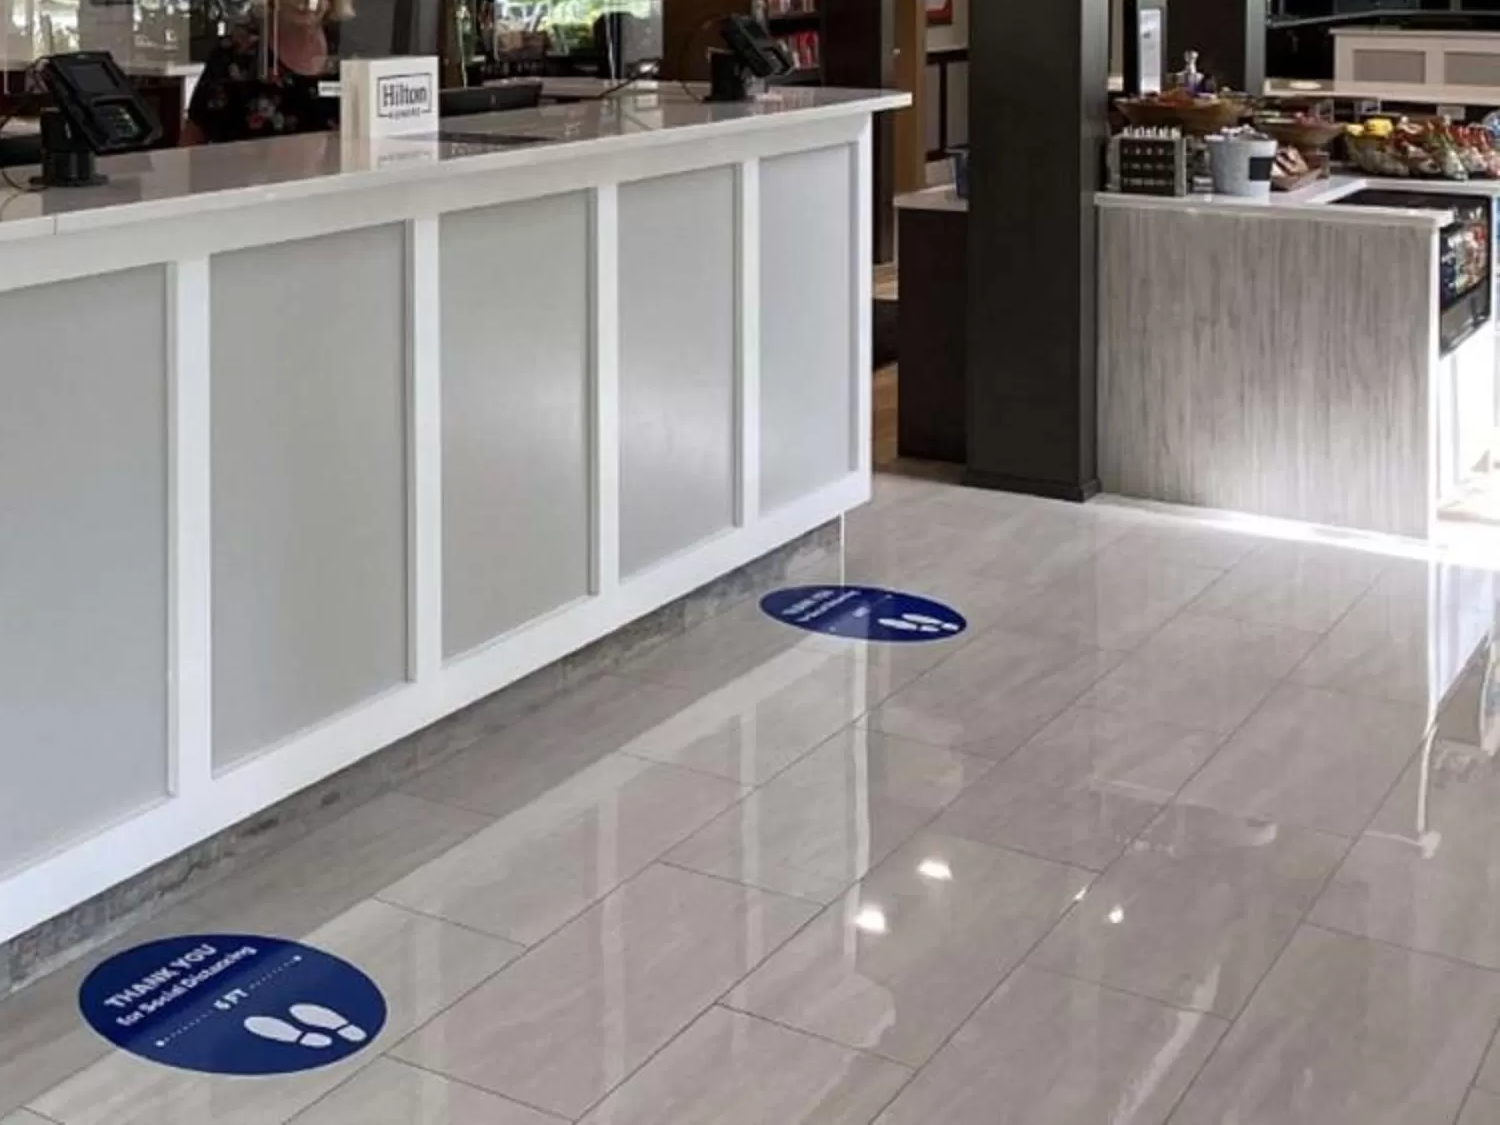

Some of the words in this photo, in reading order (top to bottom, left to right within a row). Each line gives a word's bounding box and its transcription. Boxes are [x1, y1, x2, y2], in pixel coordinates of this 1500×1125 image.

[382, 82, 427, 108] Hilton
[103, 966, 181, 1008] THANK
[168, 942, 218, 970] YOU
[221, 987, 250, 1006] FT
